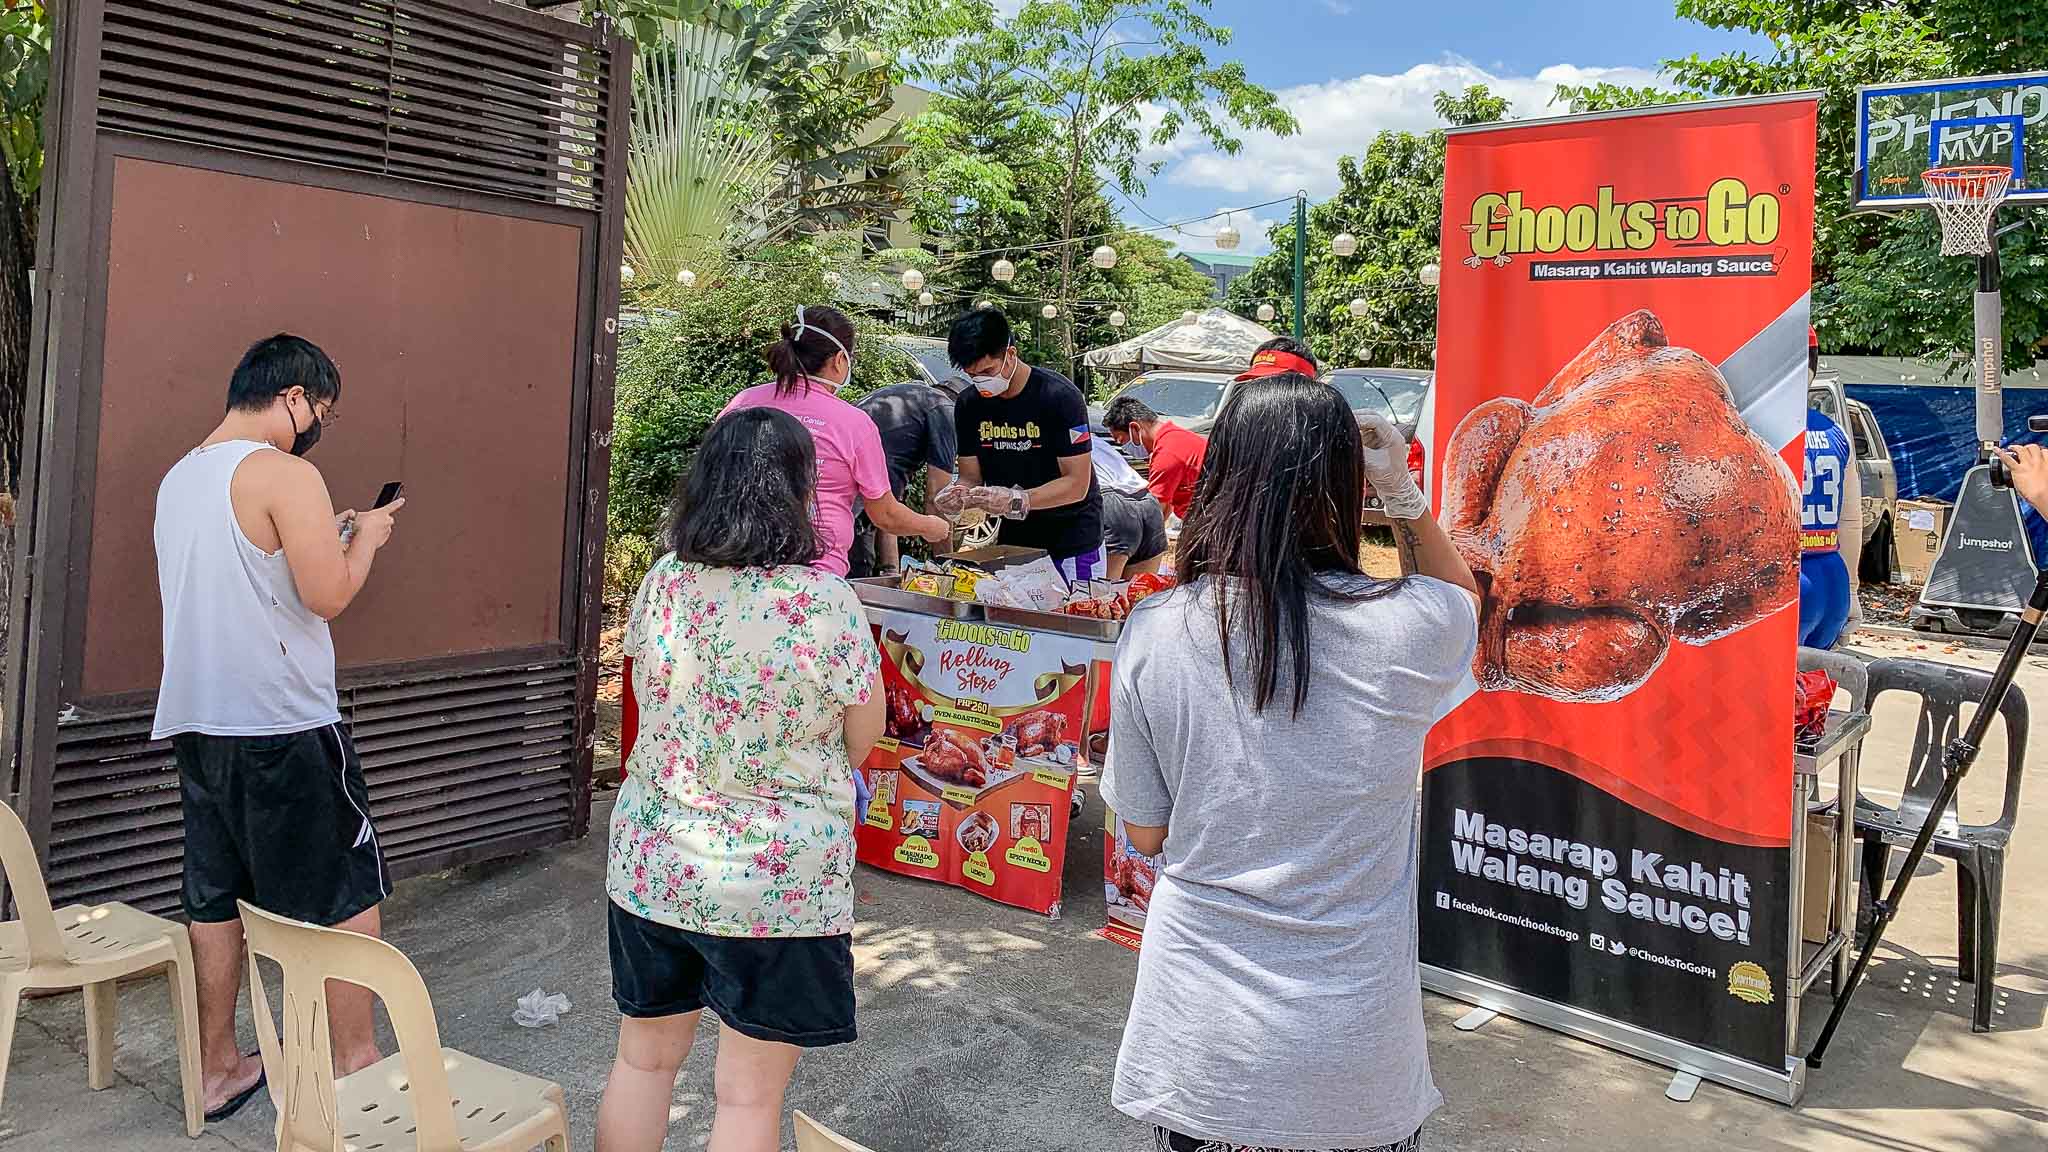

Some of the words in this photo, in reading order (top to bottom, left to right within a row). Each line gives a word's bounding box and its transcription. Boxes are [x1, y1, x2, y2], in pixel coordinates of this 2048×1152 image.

[1939, 130, 2014, 165] MVP
[1470, 185, 1657, 258] Chooks
[1665, 205, 1701, 241] to
[1705, 178, 1781, 247] Go
[1534, 263, 1601, 279] Masarap
[1603, 262, 1648, 276] Kahit
[1649, 260, 1713, 277] Walang
[1982, 337, 2000, 395] jumpshot
[1026, 421, 1041, 439] Go
[1801, 455, 1840, 526] 23
[1957, 532, 2014, 551] jumpshot
[1008, 629, 1032, 653] Go
[940, 645, 1015, 681] Rolling
[956, 667, 998, 694] Store
[1452, 807, 1619, 880] Masarap
[1630, 847, 1751, 908] Kahit
[1450, 839, 1590, 911] Walang
[1599, 877, 1751, 946] Sauce!
[1452, 897, 1580, 942] facebook.com/chookstogo
[1107, 931, 1129, 945] FREE
[1628, 945, 1717, 979] @ChooksToGoPH
